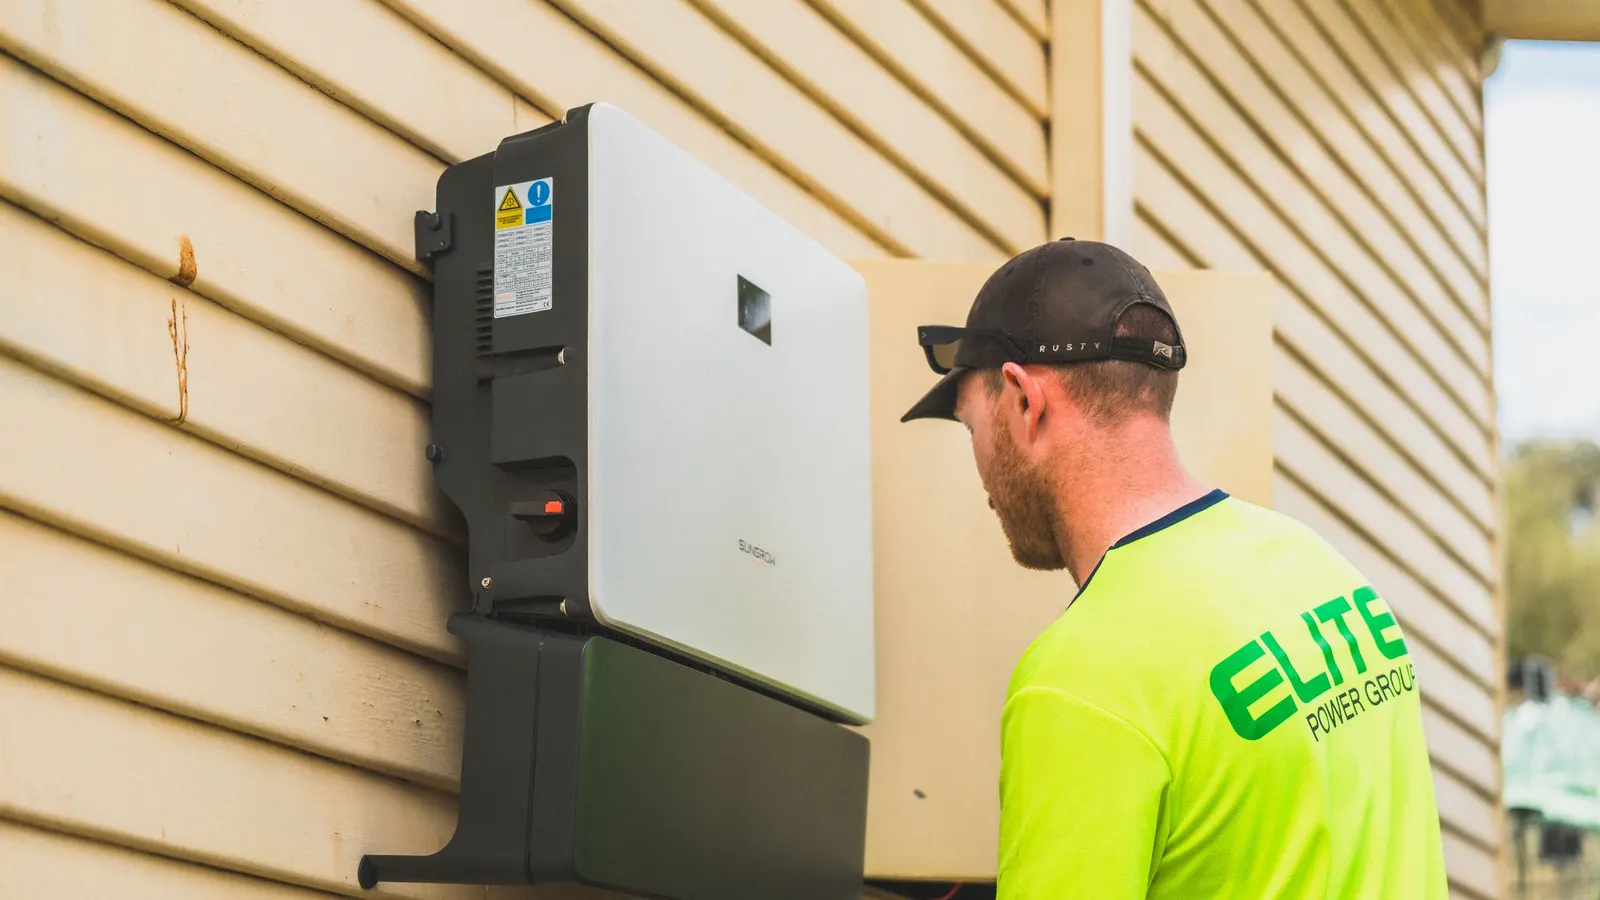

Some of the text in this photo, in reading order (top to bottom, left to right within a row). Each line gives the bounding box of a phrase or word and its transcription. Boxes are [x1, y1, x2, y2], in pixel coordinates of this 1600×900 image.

[1039, 342, 1101, 353] RUSTY
[739, 539, 776, 566] SUNGROW
[1209, 585, 1409, 741] ELITE
[1306, 687, 1366, 742] POWER
